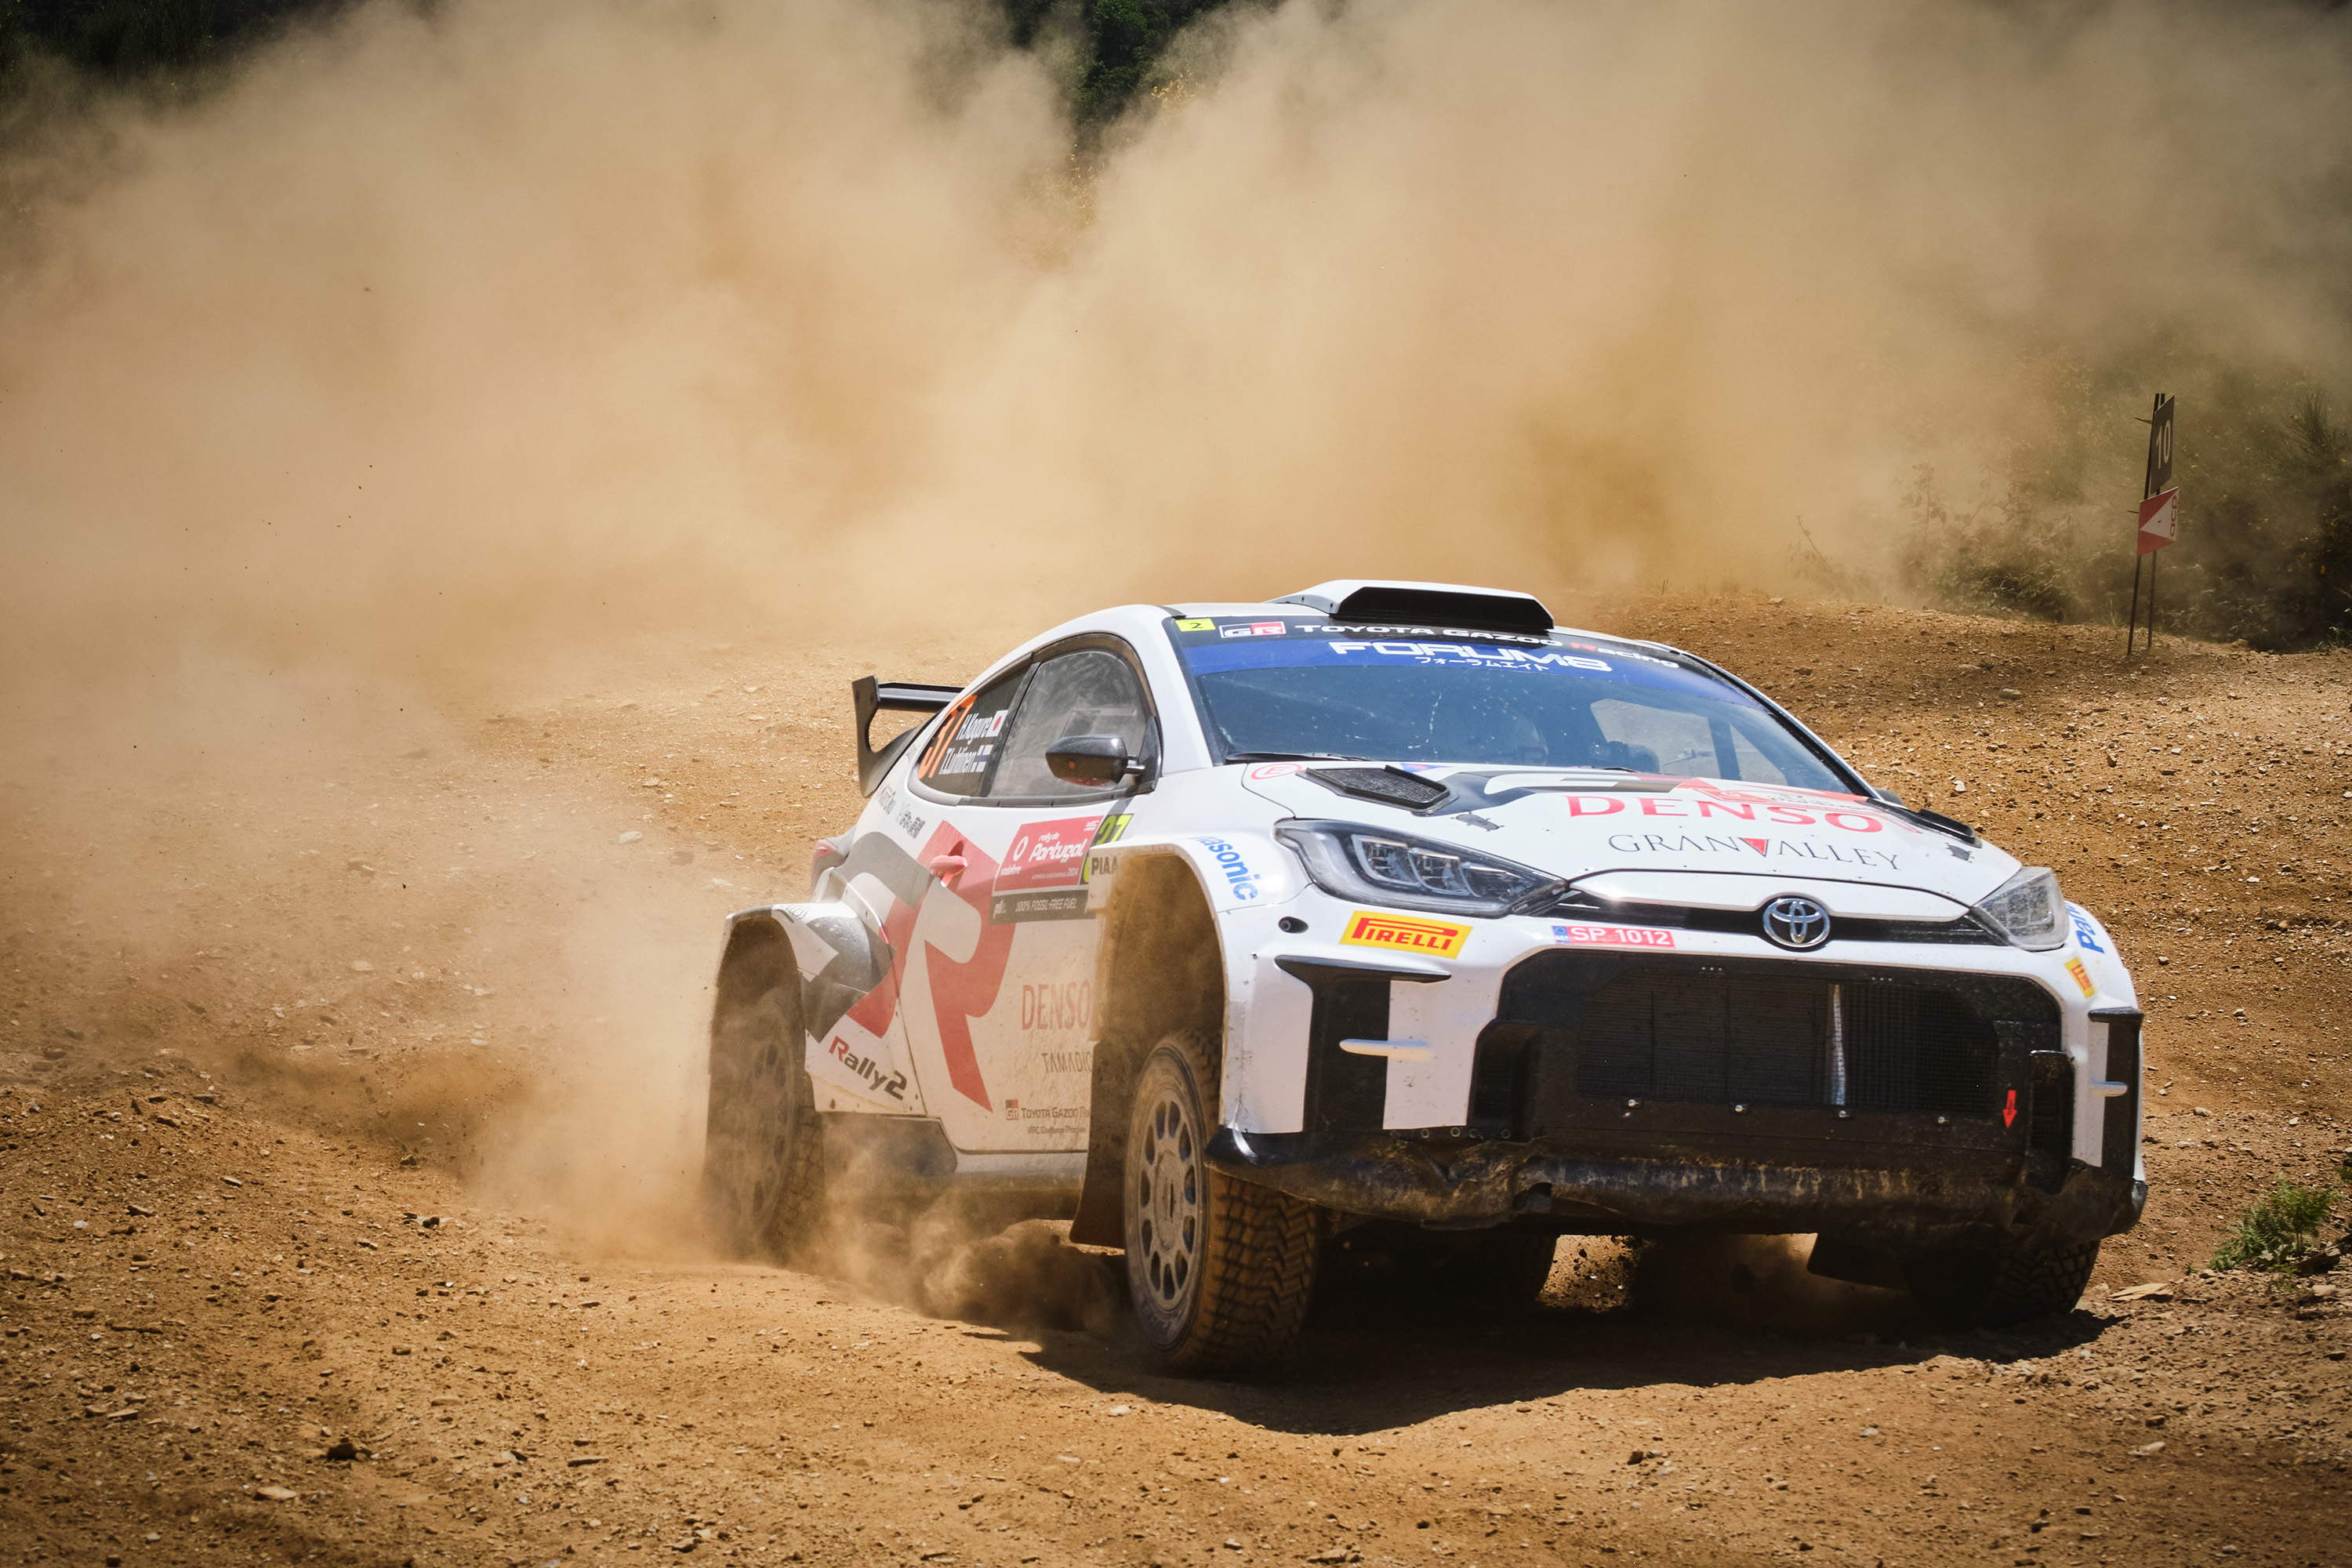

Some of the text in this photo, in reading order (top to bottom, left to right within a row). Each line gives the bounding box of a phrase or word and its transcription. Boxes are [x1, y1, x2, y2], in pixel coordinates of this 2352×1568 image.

[2156, 419, 2171, 470] 10
[1224, 626, 1284, 637] GR
[1294, 625, 1680, 669] TOYOTA GAZOO Racing
[1328, 641, 1613, 673] FORUM8
[1414, 656, 1550, 672] フォーラムエイト
[1563, 795, 1883, 833] DENSO
[1028, 838, 1088, 863] Portugal
[1351, 917, 1459, 951] PIRELLI
[1570, 927, 1671, 946] SP 1012
[1022, 980, 1091, 1030] DENSO
[829, 1035, 908, 1101] Rally2
[1021, 1107, 1051, 1120] TOYOTA
[1051, 1106, 1078, 1119] GAZOO
